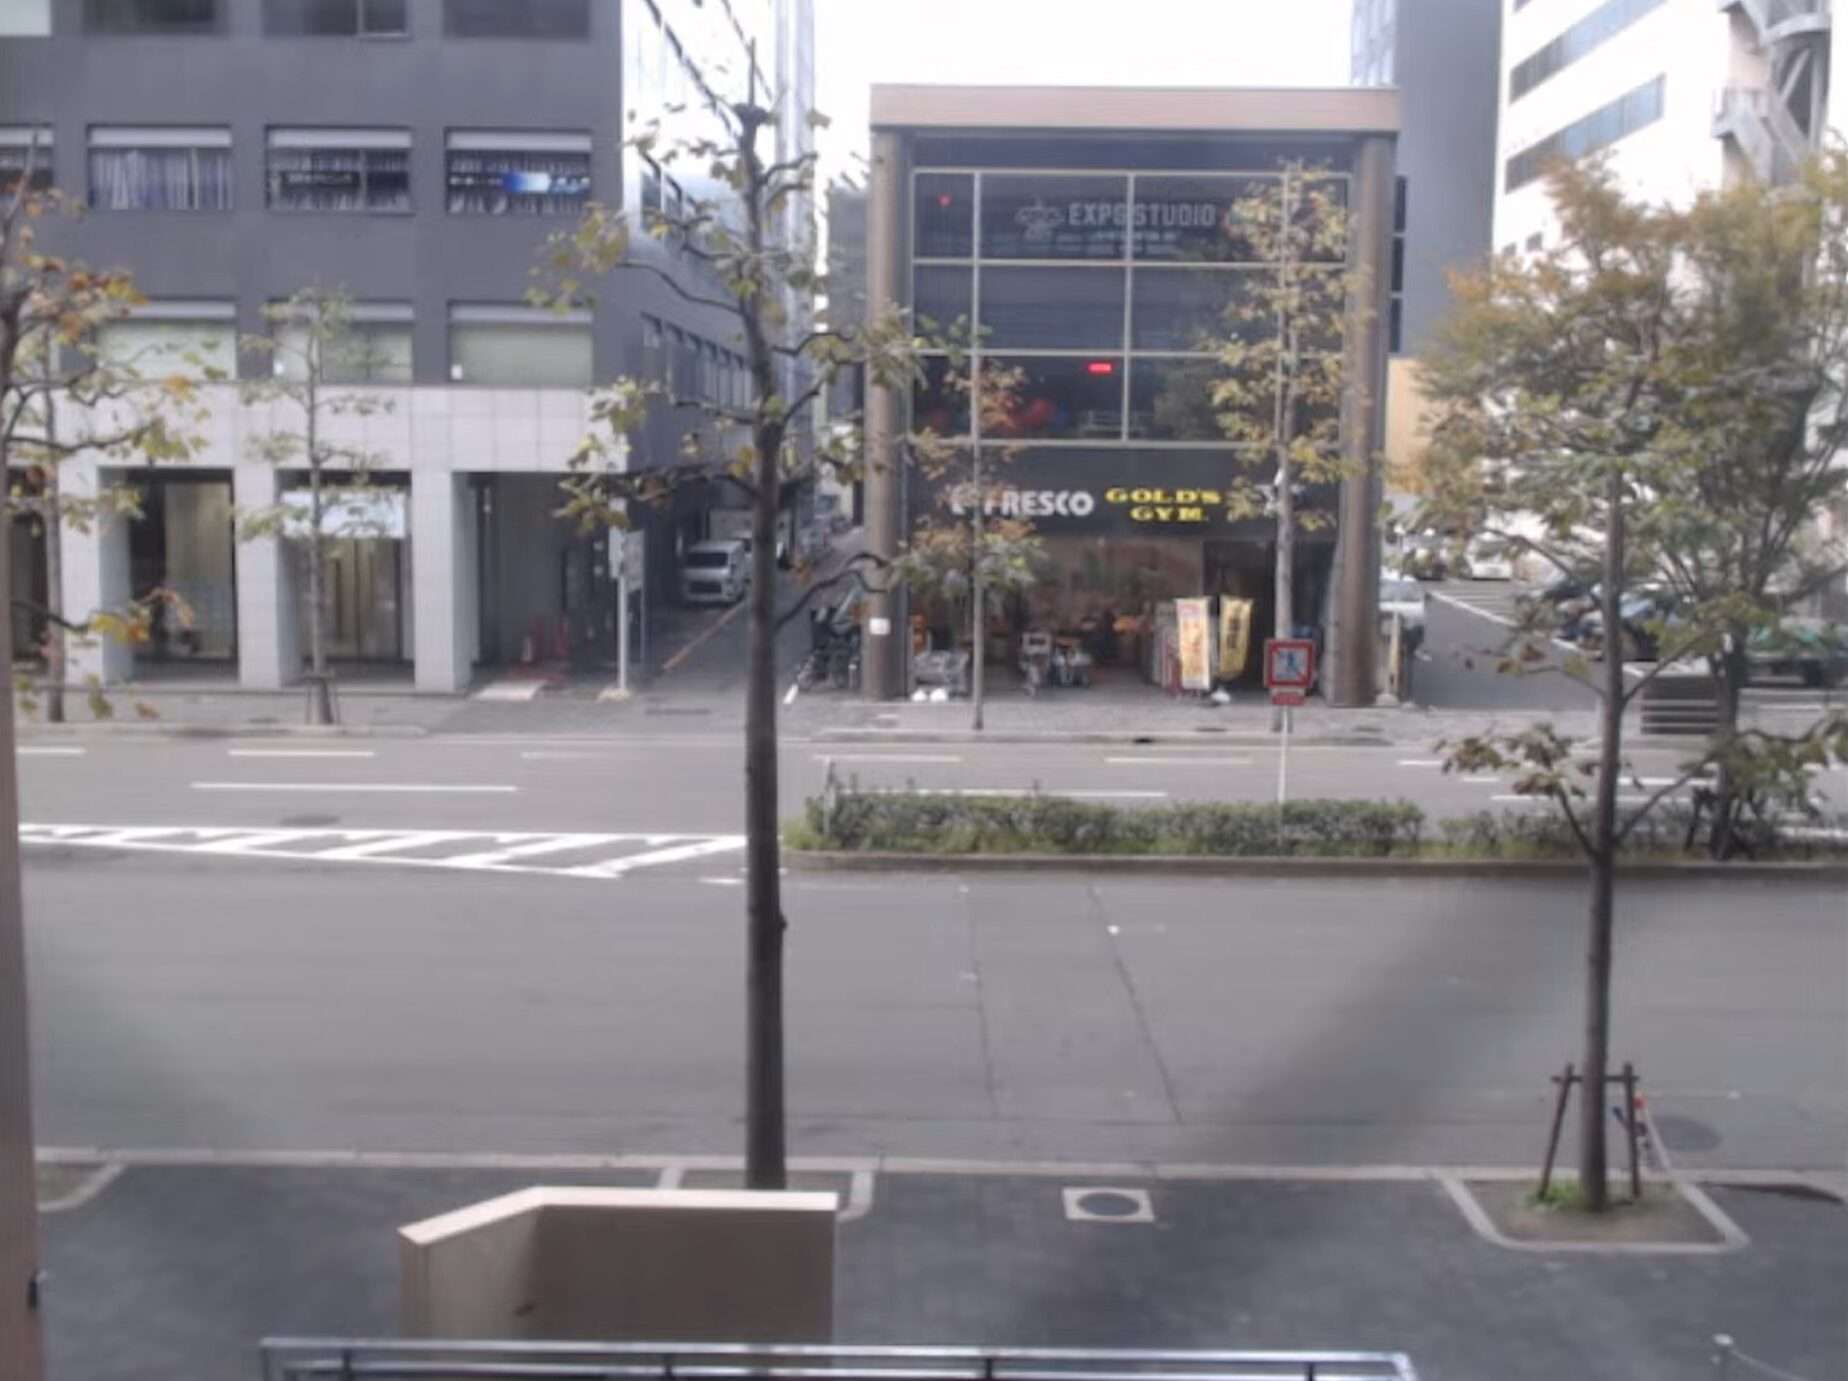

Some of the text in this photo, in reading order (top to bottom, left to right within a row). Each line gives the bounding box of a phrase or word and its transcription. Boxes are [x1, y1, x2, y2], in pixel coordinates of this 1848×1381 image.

[1134, 203, 1217, 226] STUDIO
[1104, 488, 1221, 504] GOLD'S
[1130, 506, 1203, 521] GYM
